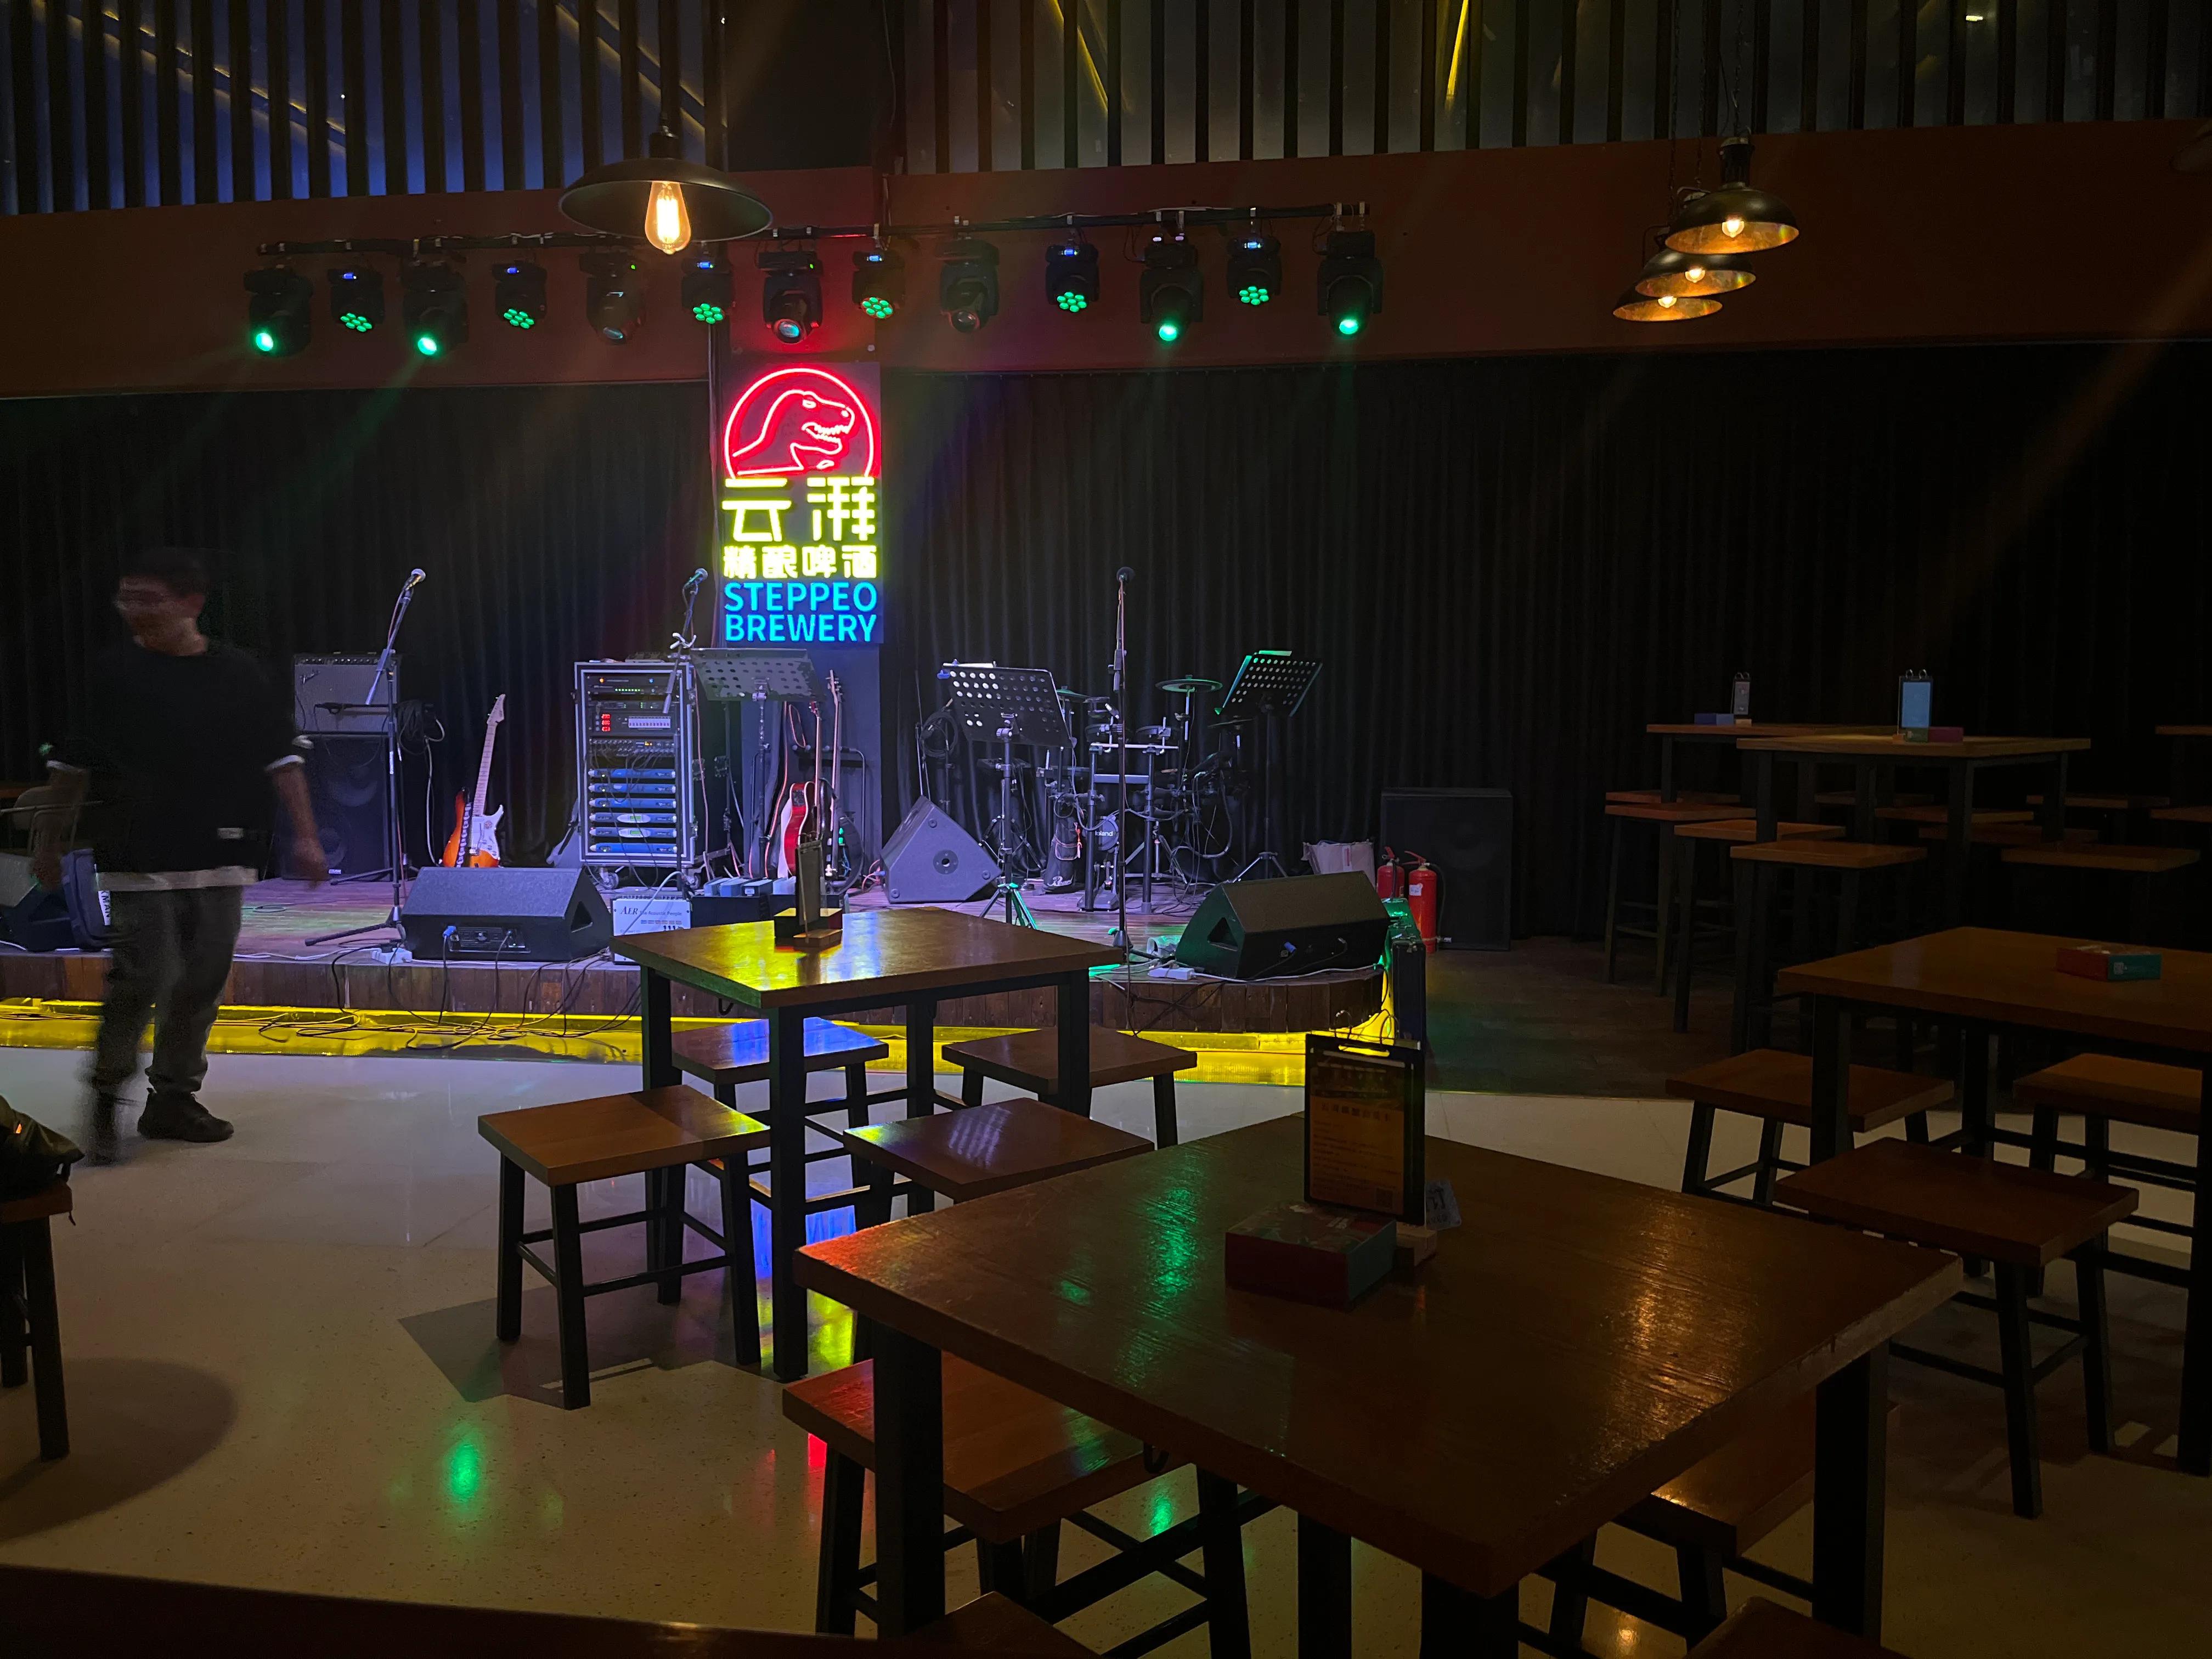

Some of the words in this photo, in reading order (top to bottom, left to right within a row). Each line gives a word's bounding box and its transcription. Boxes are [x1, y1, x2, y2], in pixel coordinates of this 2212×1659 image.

[722, 477, 875, 541] 云湃
[723, 544, 877, 579] 精酿啤酒
[724, 582, 877, 612] STEPPEO
[725, 614, 877, 642] BREWERY
[620, 906, 639, 915] AER
